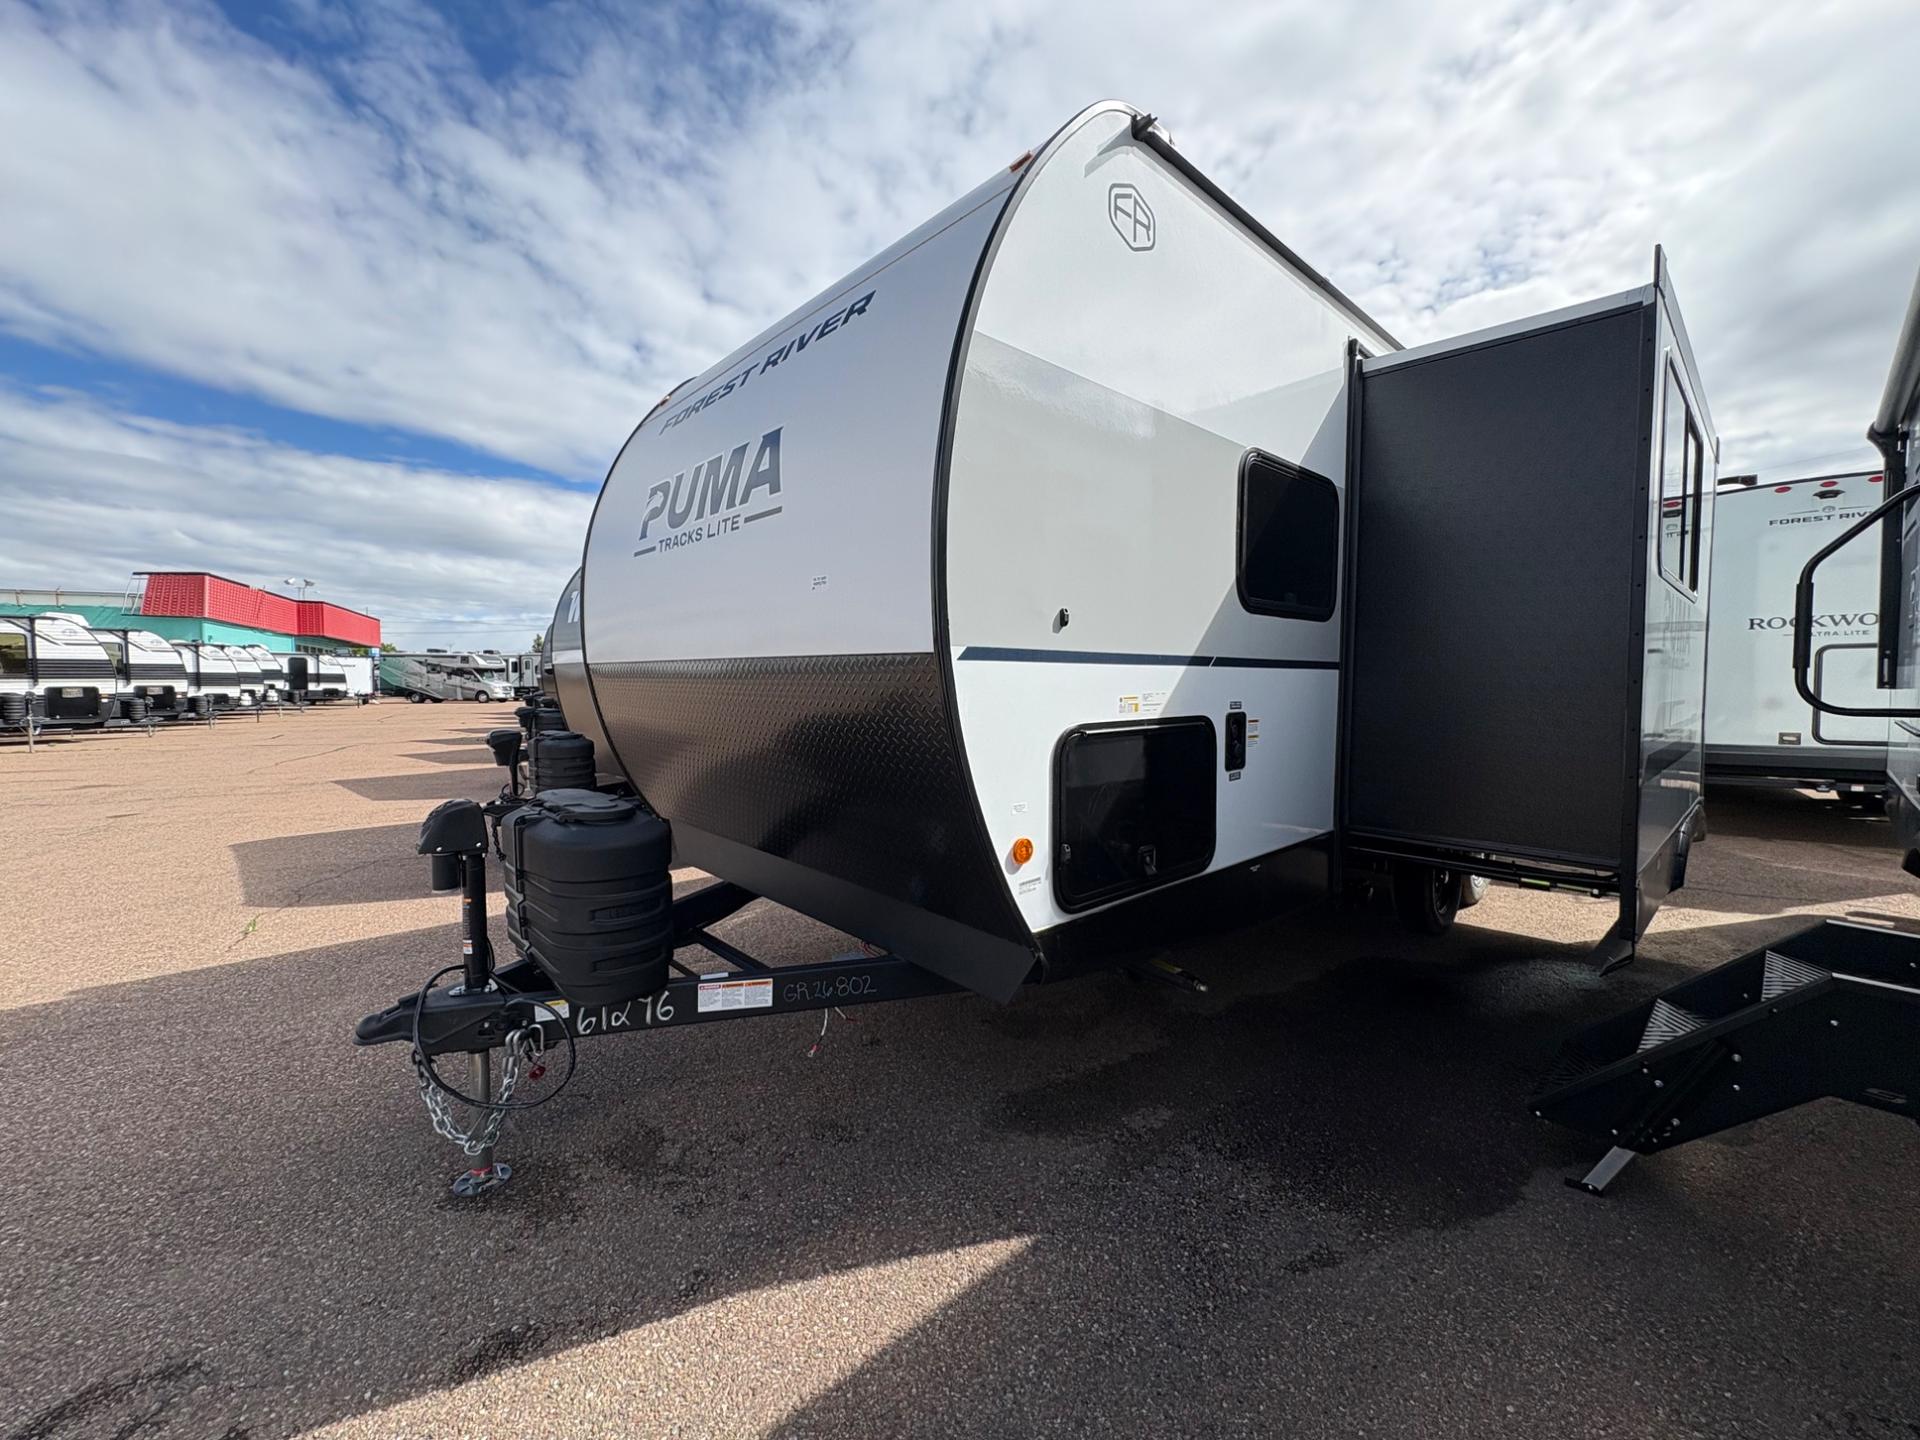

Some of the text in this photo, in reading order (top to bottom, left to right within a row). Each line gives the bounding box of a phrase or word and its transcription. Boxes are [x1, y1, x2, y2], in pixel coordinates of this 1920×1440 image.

[659, 290, 877, 436] FOREST RIVER
[638, 426, 784, 541] PUMA
[658, 514, 741, 553] TRACKS LITE
[1768, 510, 1873, 526] FOREST RIV
[1843, 629, 1871, 637] LITE
